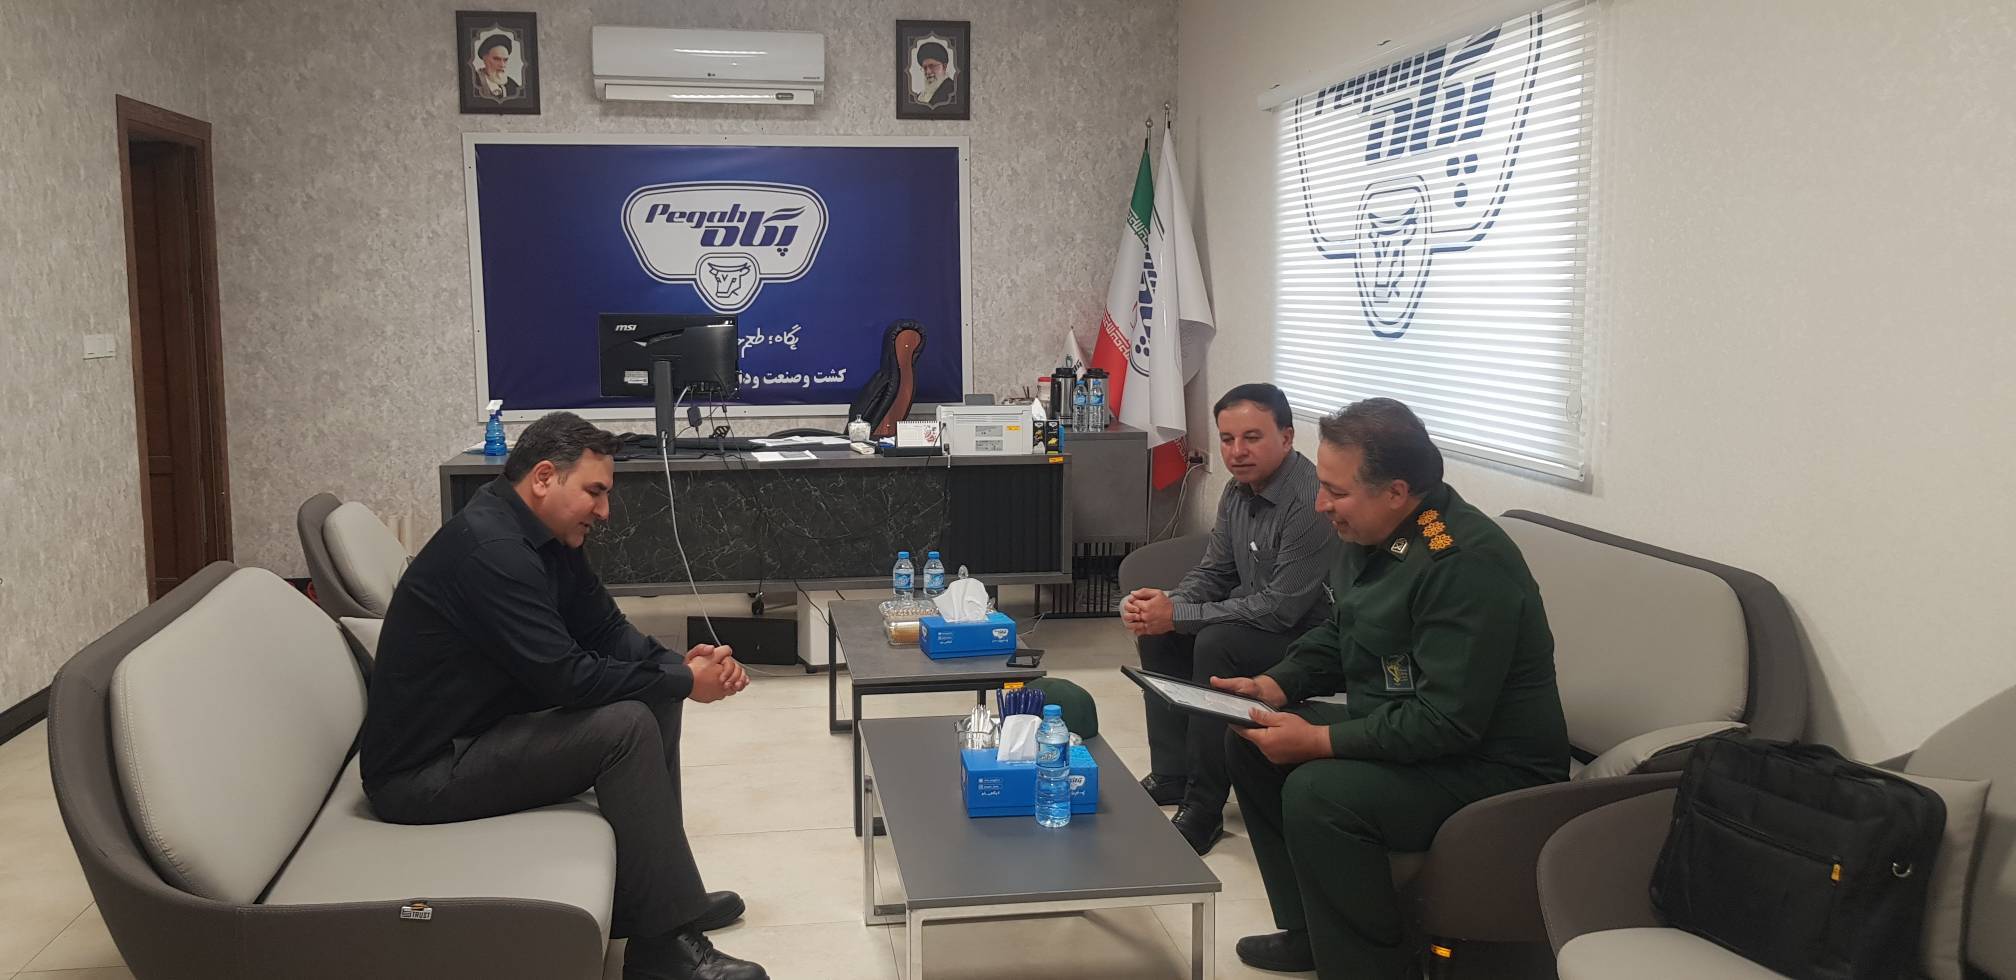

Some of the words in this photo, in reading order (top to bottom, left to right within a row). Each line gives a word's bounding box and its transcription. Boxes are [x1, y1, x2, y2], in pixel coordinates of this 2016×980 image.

[645, 203, 747, 229] Pegah
[700, 205, 807, 257] پگاه
[813, 368, 847, 384] کشت
